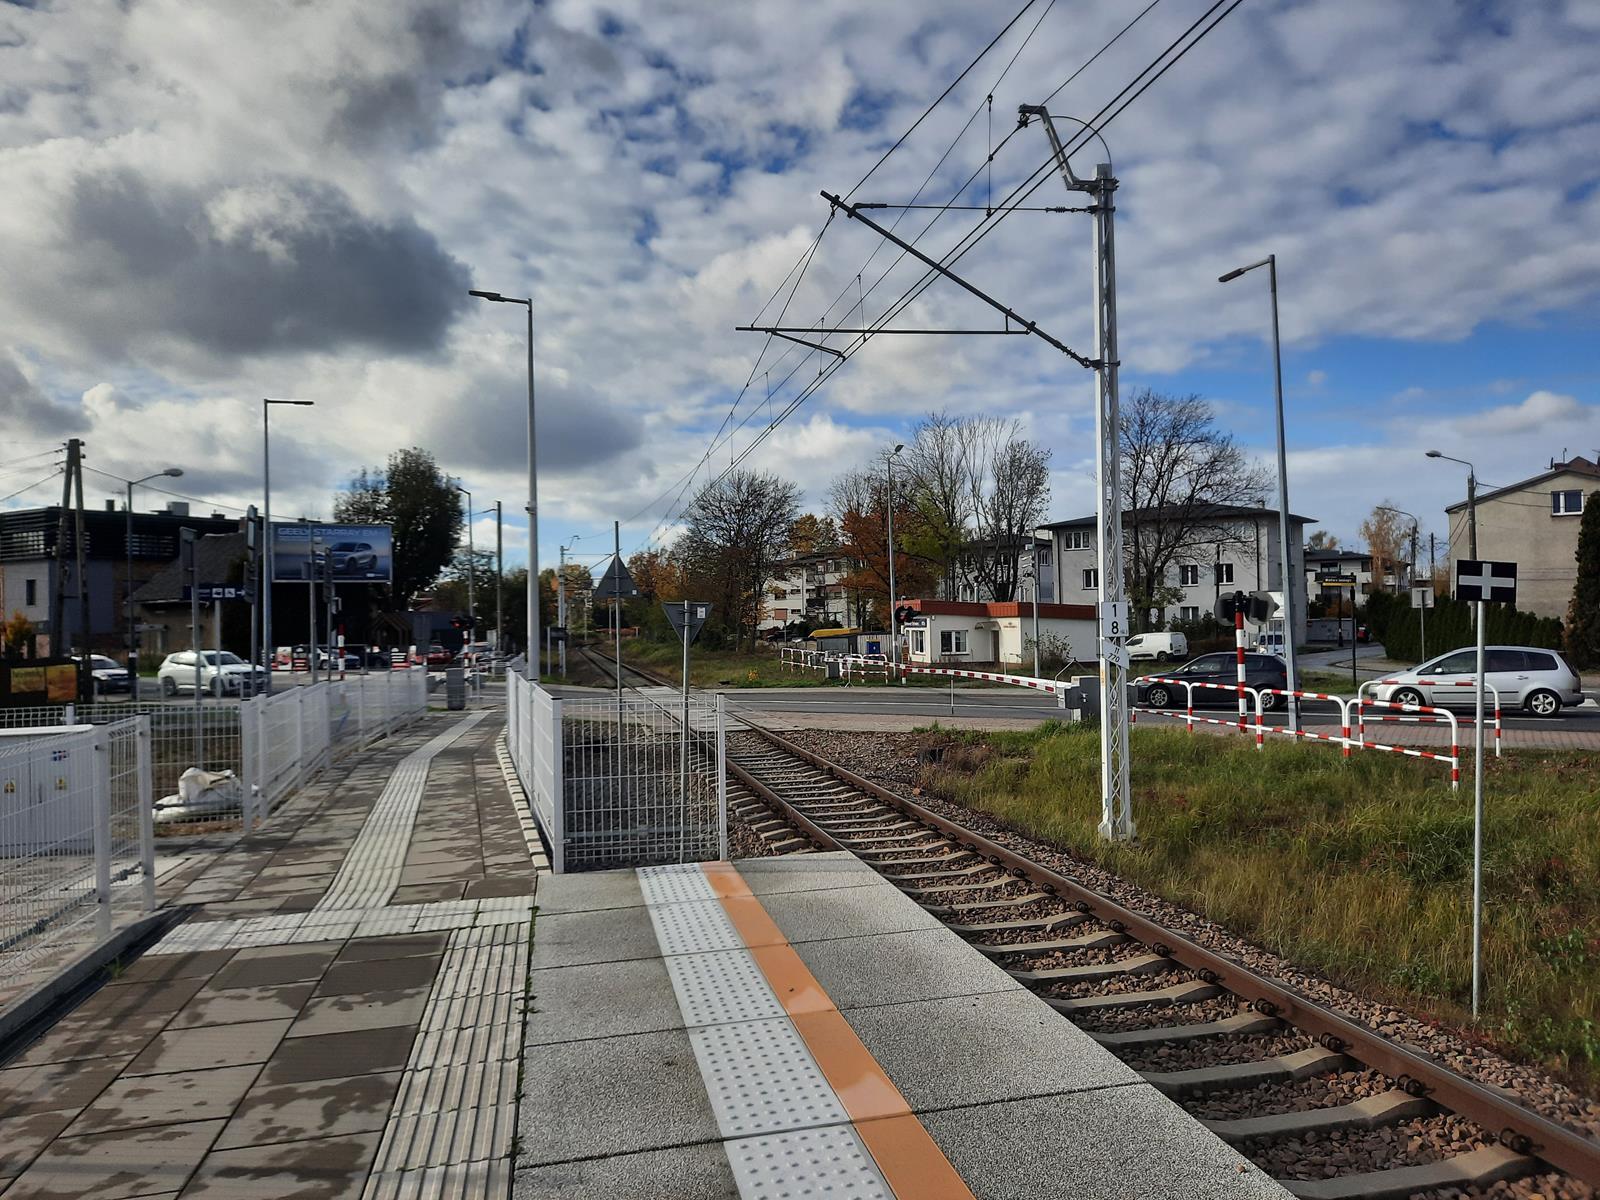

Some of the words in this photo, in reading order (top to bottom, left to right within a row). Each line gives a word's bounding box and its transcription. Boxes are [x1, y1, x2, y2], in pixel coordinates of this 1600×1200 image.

[313, 528, 360, 537] STARRAY
[1112, 604, 1117, 618] 1
[1111, 621, 1119, 634] 8
[1107, 653, 1120, 662] 770
